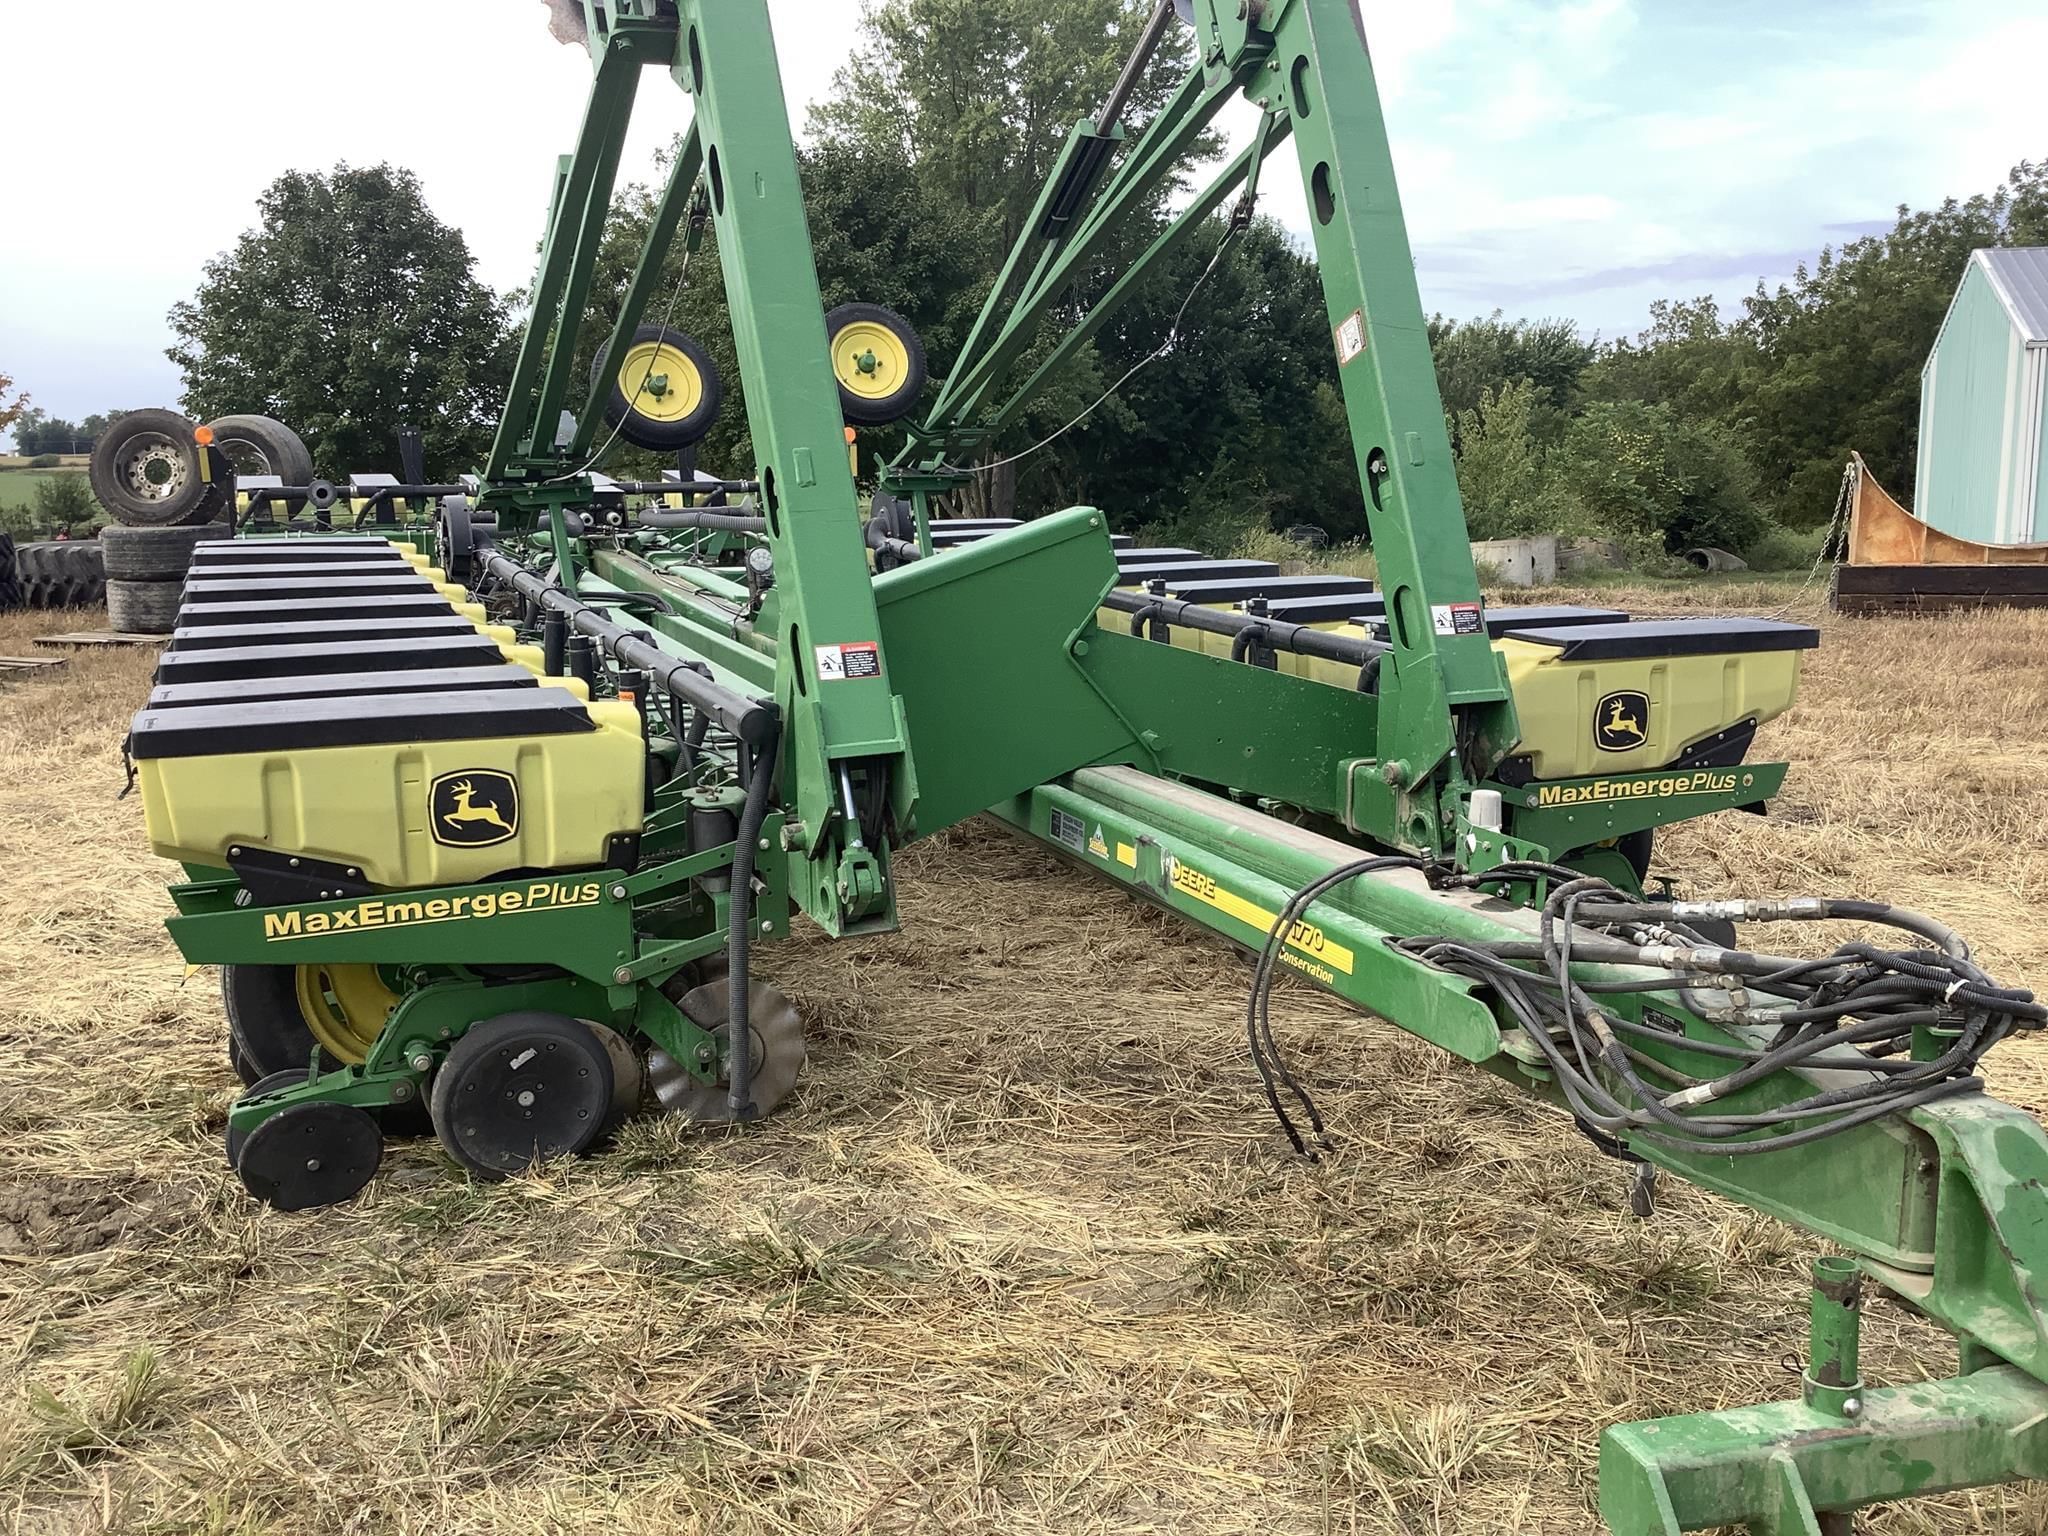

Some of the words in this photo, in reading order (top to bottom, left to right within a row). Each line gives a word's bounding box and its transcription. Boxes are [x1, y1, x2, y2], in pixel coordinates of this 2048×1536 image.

[1539, 772, 1737, 807] MaxEmergePlus
[1170, 854, 1217, 899] DEERE
[264, 882, 601, 938] MaxEmergePlus
[1278, 945, 1334, 985] Conservation
